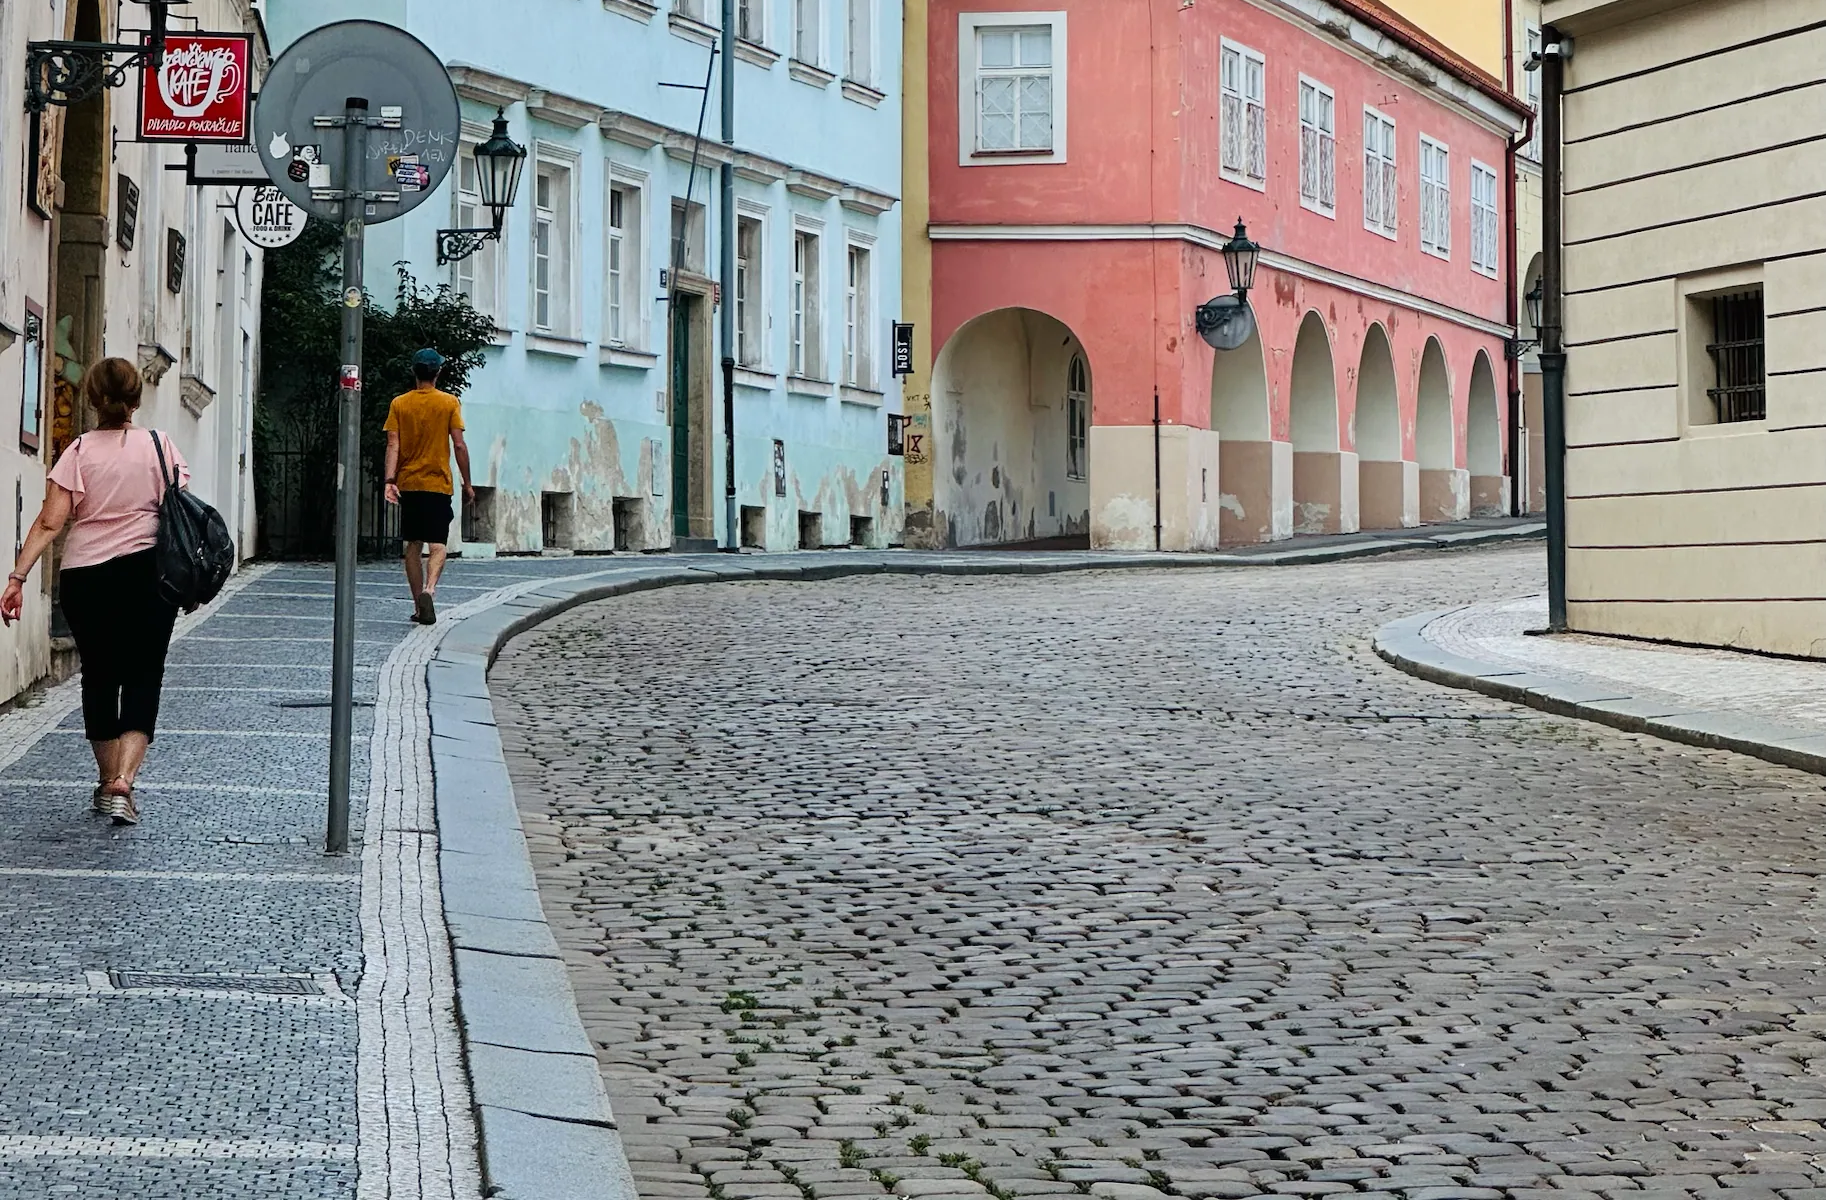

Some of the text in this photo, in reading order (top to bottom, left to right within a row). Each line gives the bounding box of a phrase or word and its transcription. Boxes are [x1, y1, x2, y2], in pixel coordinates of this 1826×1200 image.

[169, 66, 210, 105] KAFE
[147, 117, 241, 133] DIVADLO POKRAČUJE
[252, 185, 284, 202] Bistr
[252, 203, 293, 226] CAFE
